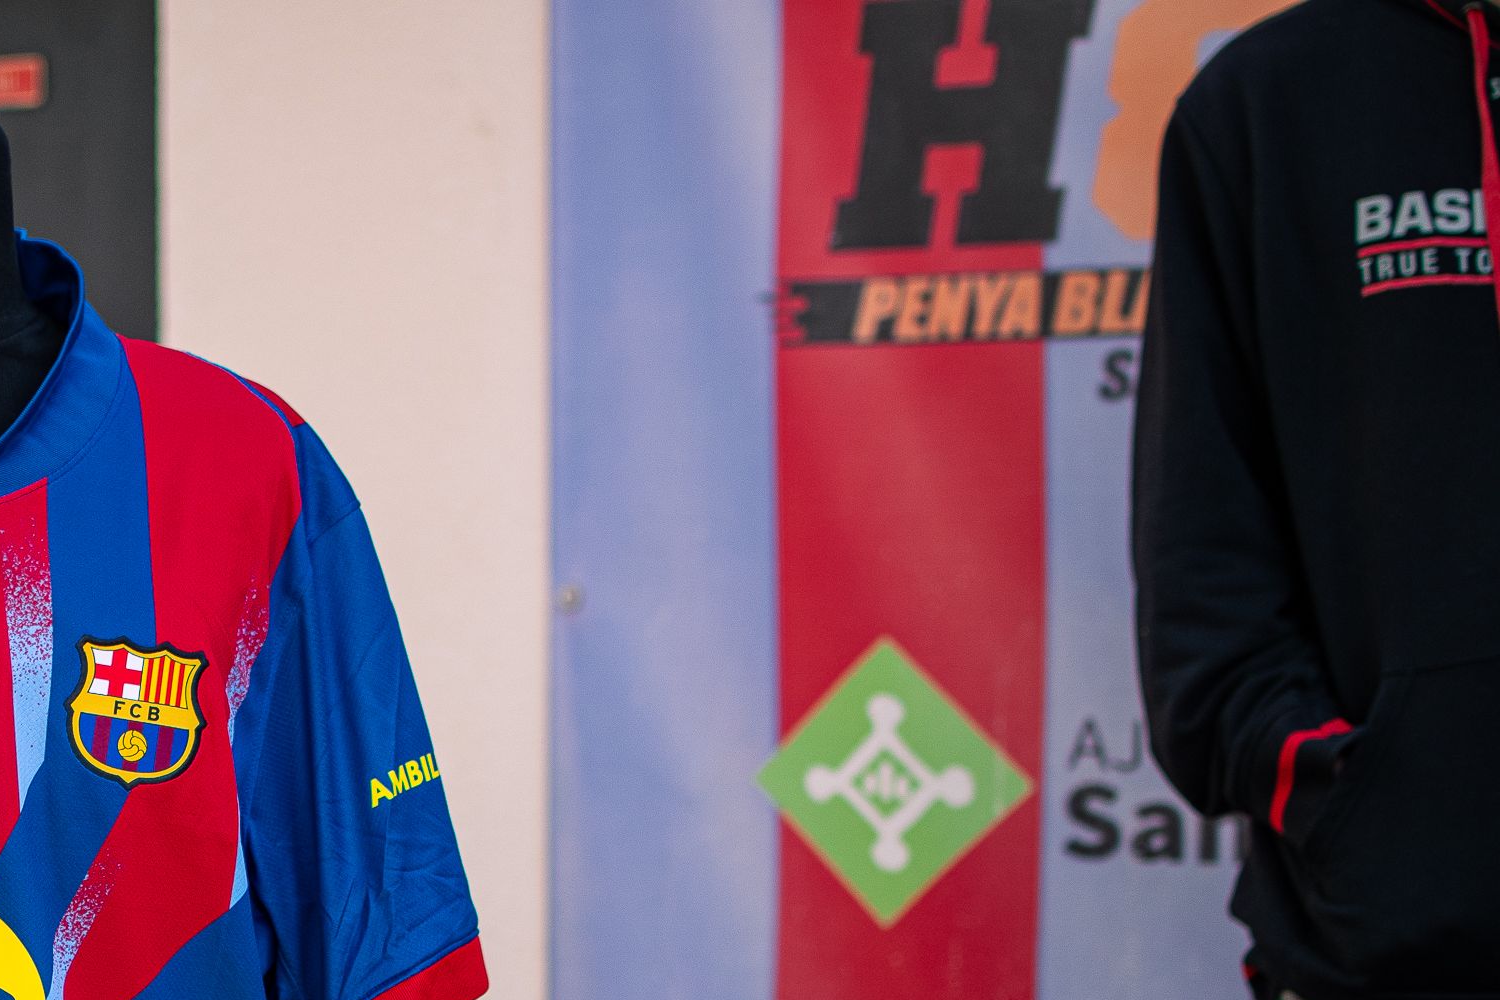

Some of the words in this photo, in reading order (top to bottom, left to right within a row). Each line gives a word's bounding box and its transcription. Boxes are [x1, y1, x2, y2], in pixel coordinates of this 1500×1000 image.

[1357, 248, 1439, 284] TRUE
[853, 270, 1042, 344] PENYA
[370, 753, 440, 808] AMBIL
